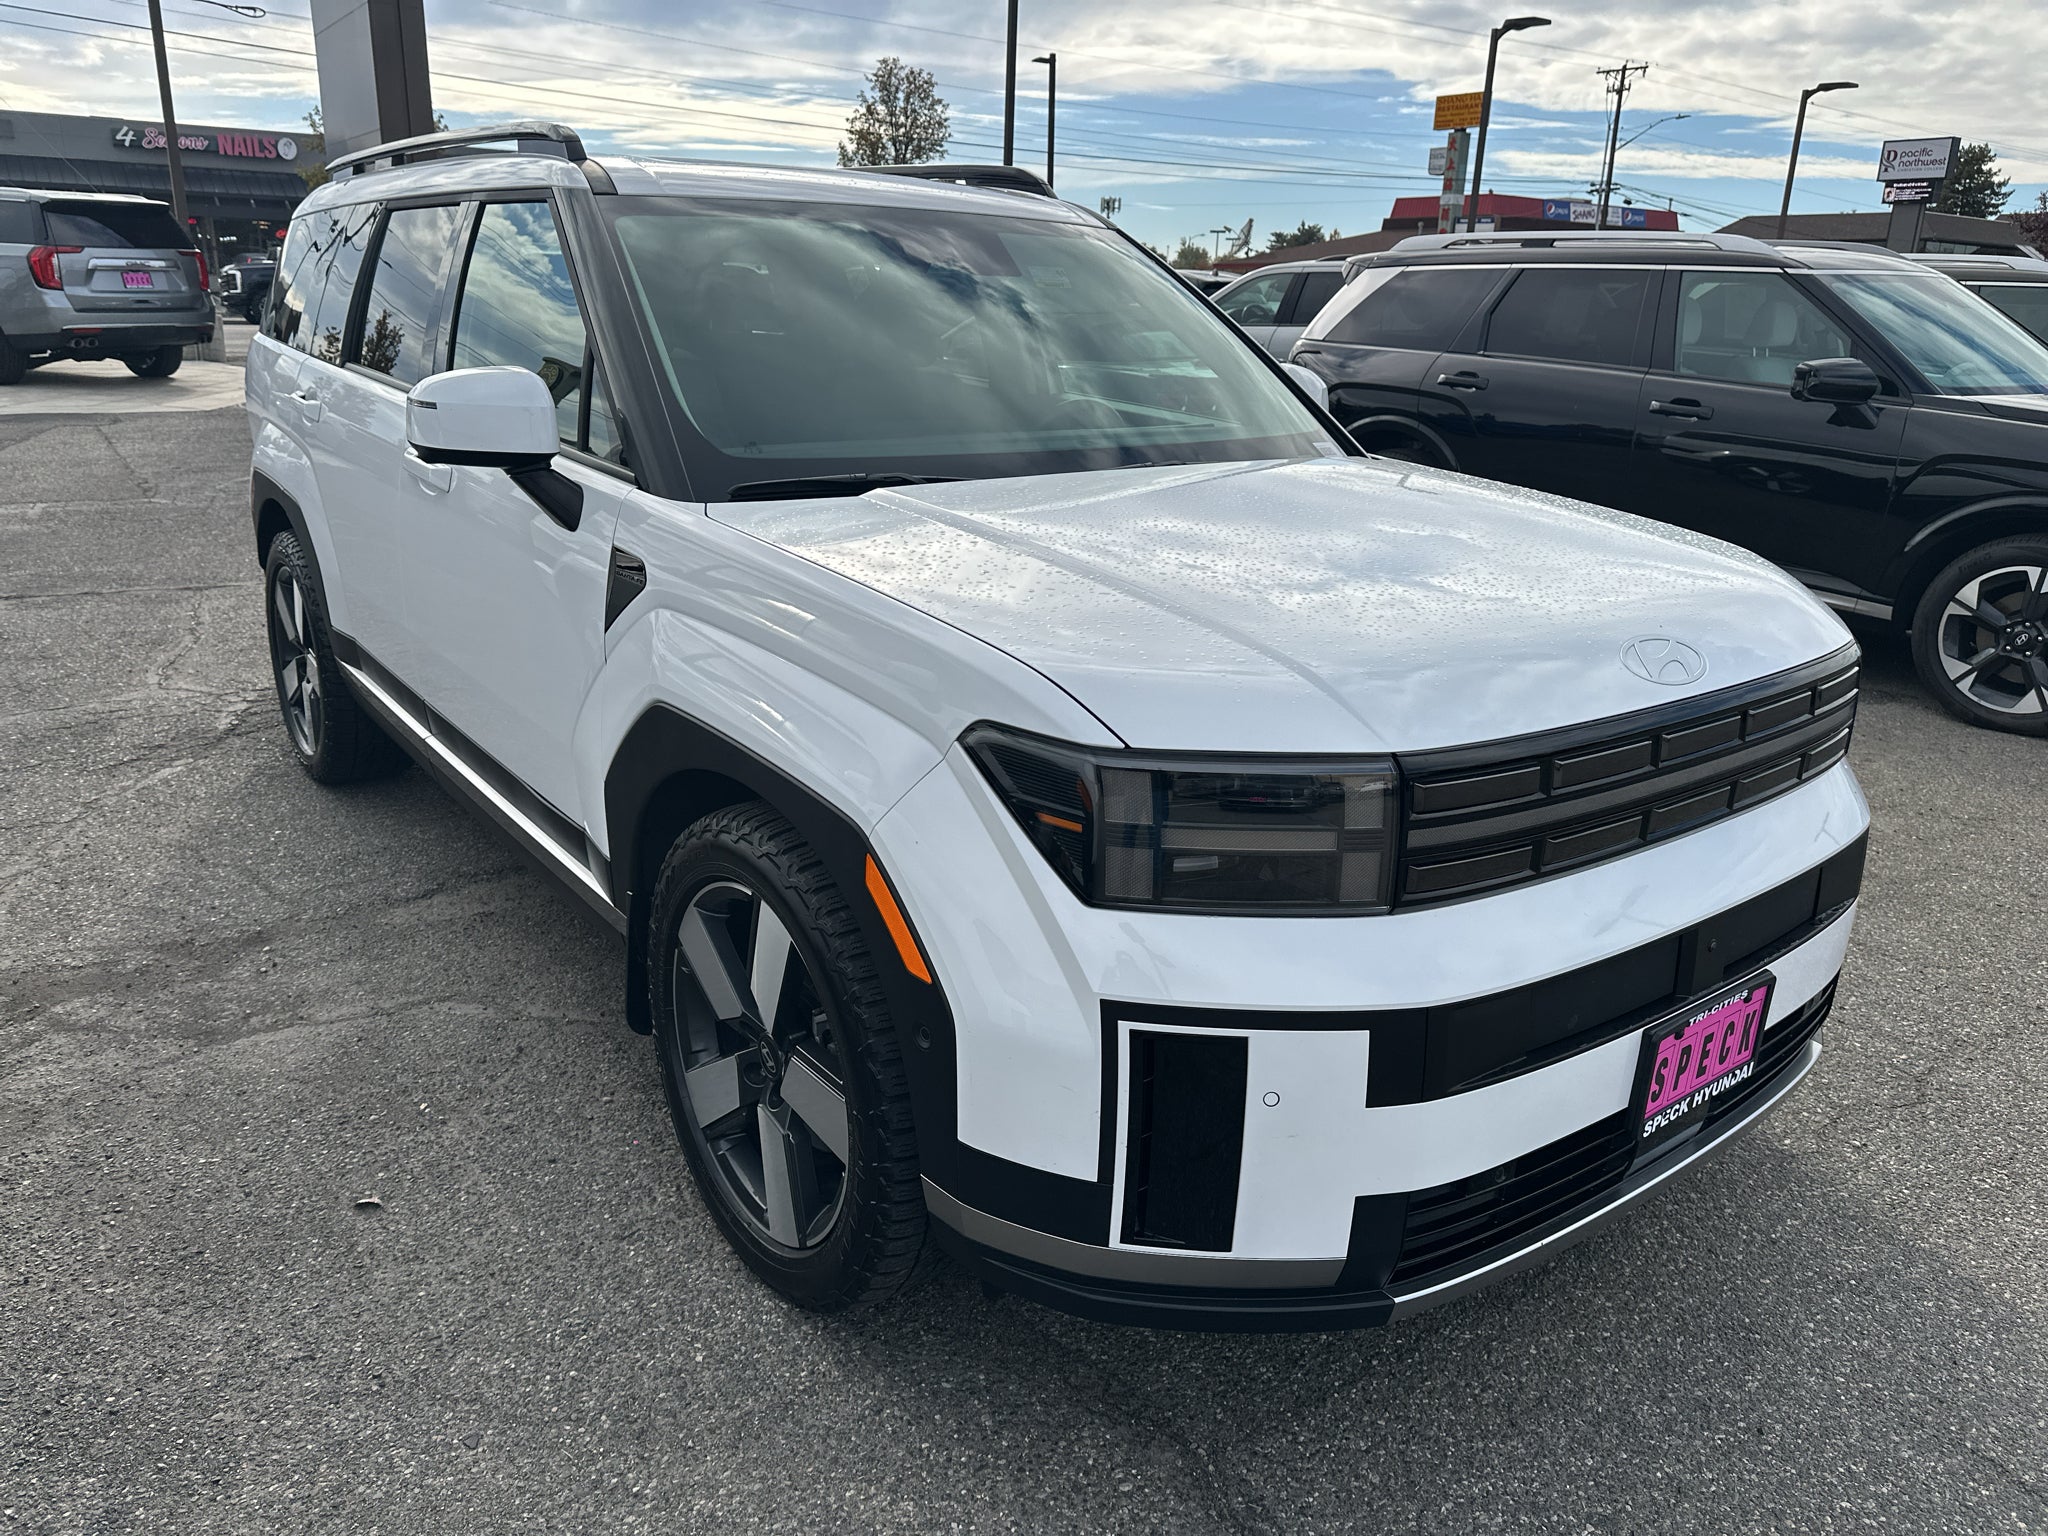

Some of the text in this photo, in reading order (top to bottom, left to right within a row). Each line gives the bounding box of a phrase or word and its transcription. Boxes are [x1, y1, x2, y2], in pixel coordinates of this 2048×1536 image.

[1437, 93, 1482, 105] SHANGHA
[1437, 102, 1482, 112] RESTAURAN
[115, 125, 278, 159] 4 Seons NAILS
[1899, 148, 1934, 160] pacific
[1898, 157, 1947, 167] northwest
[1572, 208, 1596, 221] SHANG
[616, 570, 635, 581] SANTA
[1688, 989, 1749, 1027] TRI-CITIES
[1650, 1008, 1758, 1104] SPECK
[1642, 1061, 1755, 1138] SPECK HYUNDAI
